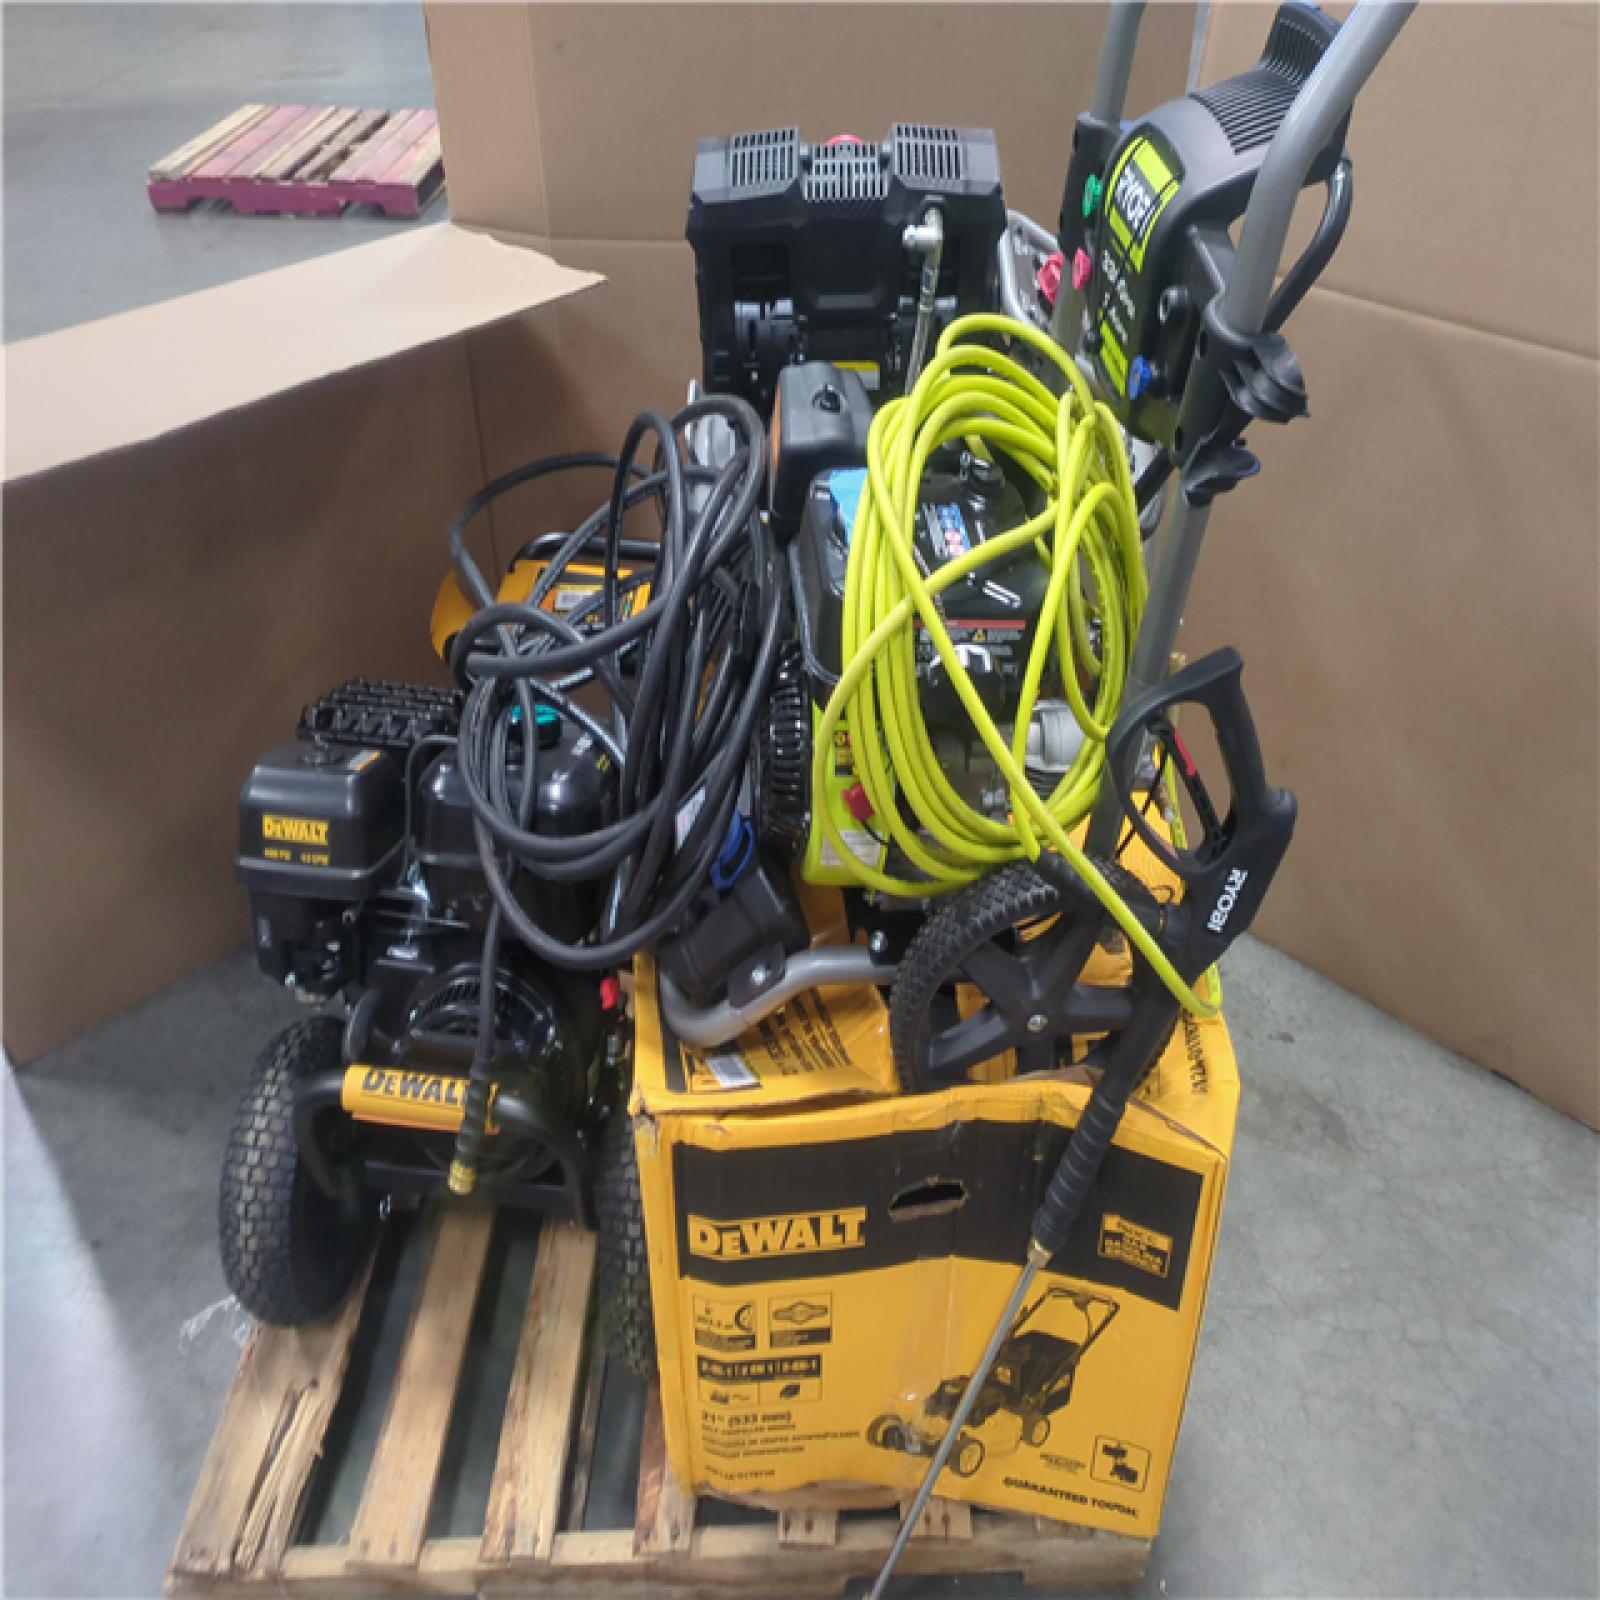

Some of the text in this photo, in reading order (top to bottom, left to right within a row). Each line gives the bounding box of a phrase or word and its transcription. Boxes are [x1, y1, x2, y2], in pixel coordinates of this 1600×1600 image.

[263, 815, 328, 845] DEWALT
[1207, 868, 1248, 932] RYOBI
[363, 1067, 468, 1106] DEWAL
[687, 1206, 866, 1260] DEWALT
